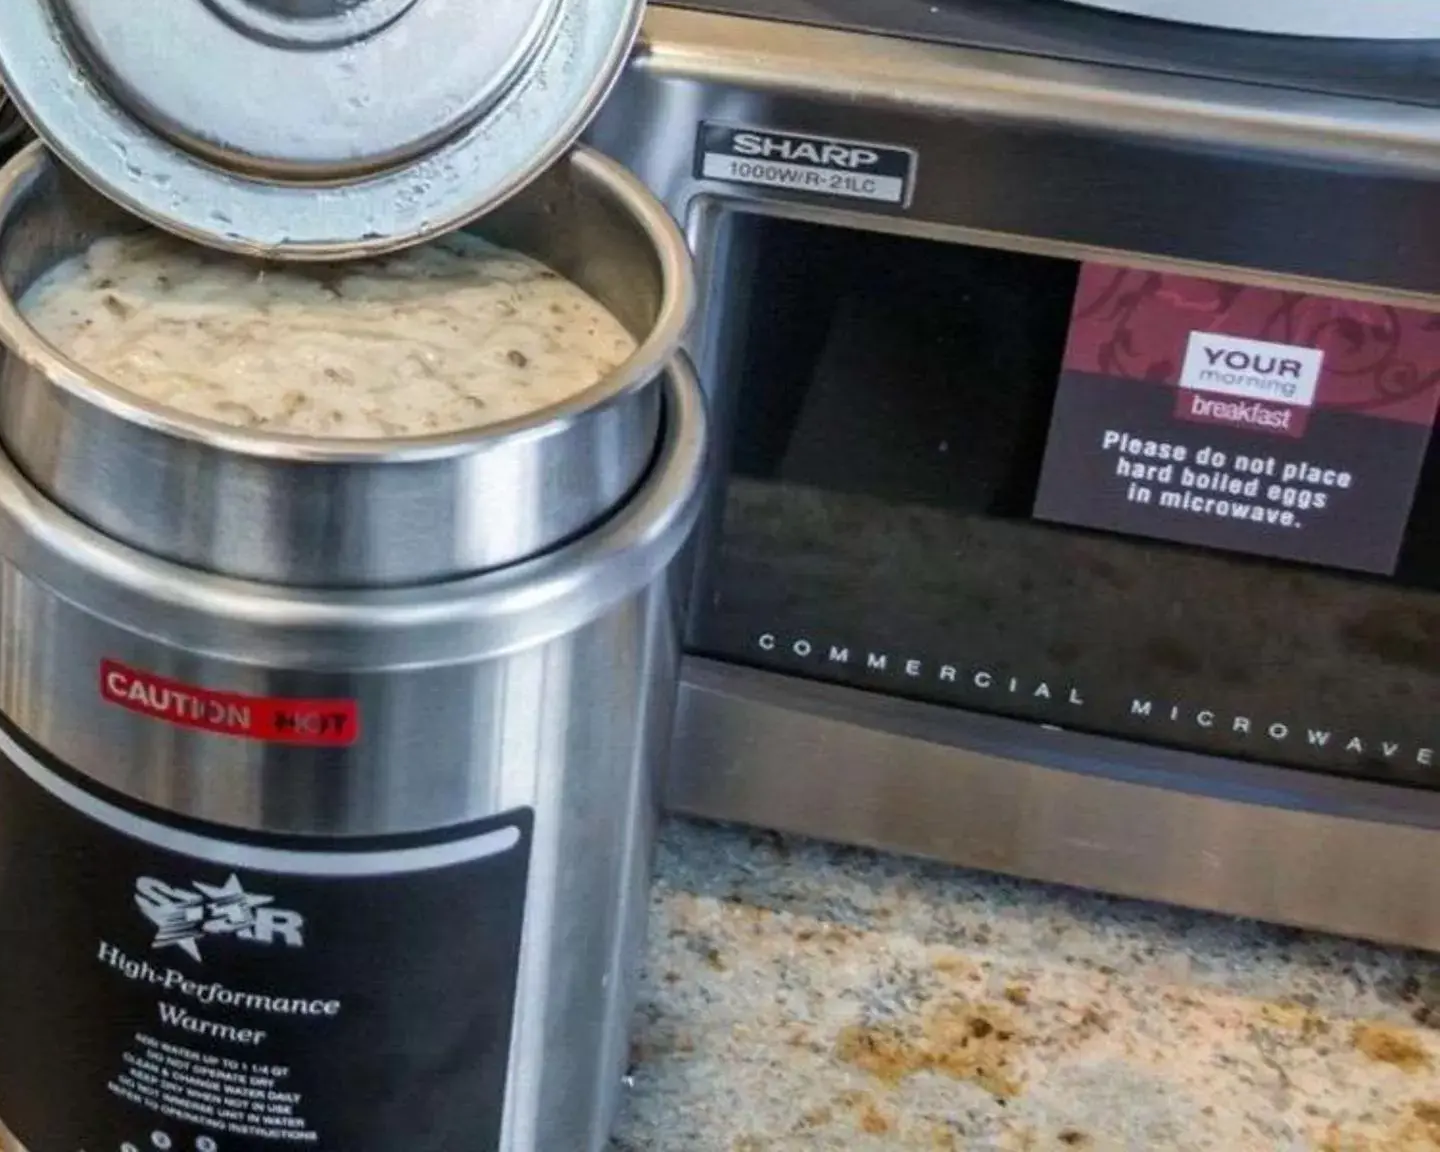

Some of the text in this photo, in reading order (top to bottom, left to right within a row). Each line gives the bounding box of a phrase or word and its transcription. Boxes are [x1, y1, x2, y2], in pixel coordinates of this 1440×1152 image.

[733, 133, 879, 168] SHARP
[731, 161, 876, 194] 1000W/R-21LC
[1204, 346, 1303, 379] YOUR
[1199, 368, 1297, 398] morning
[1191, 396, 1292, 429] breakfast
[1102, 430, 1352, 489] Please do not place
[1116, 457, 1327, 509] hard boiled eggs
[1127, 481, 1303, 529] in microwave.
[107, 671, 252, 730] CAUTION
[758, 634, 1435, 766] COMMERCIAL MICROWAVE
[98, 940, 341, 1017] High-Performance
[158, 1001, 267, 1046] Warmer
[166, 1056, 190, 1071] NOT
[222, 1058, 239, 1070] TO
[224, 1096, 249, 1110] NOT
